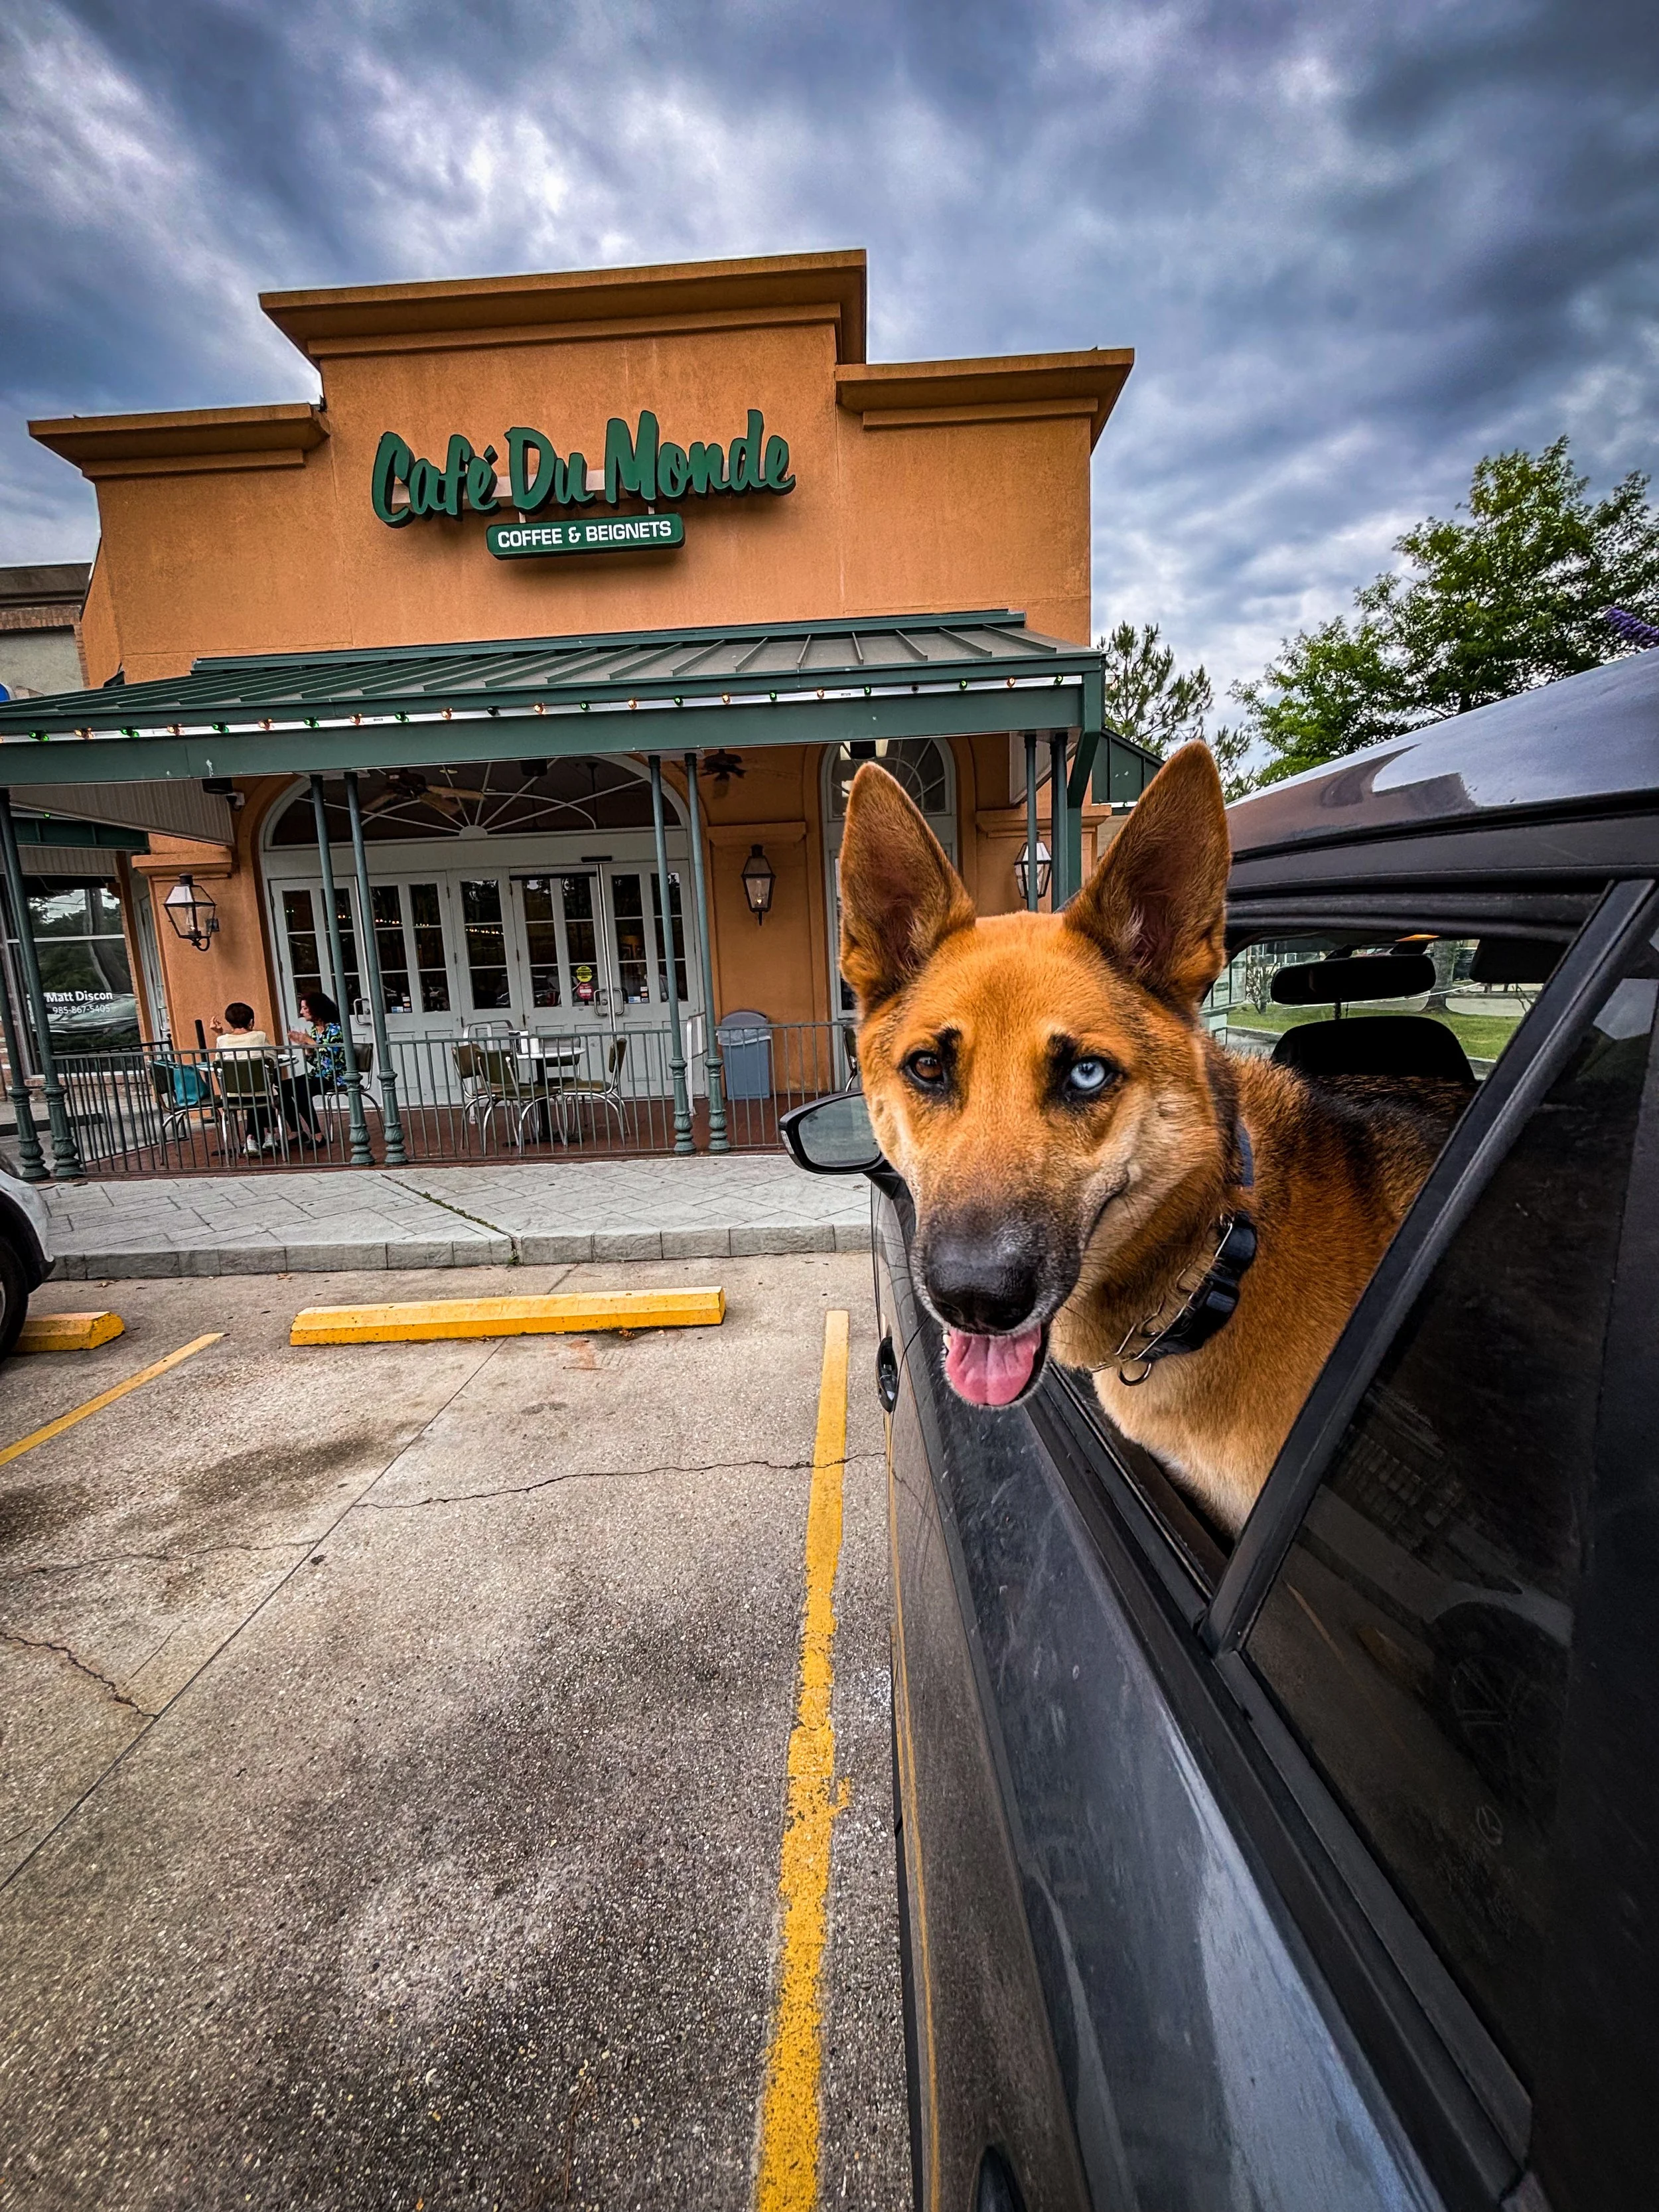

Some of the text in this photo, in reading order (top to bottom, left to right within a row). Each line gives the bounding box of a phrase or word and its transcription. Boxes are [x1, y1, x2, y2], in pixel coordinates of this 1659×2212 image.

[372, 409, 795, 526] Café Du Monde
[498, 520, 672, 548] COFFEE & BEIGNETS
[46, 990, 113, 1003] Matt Discon
[52, 1004, 111, 1014] 985-867-5405
